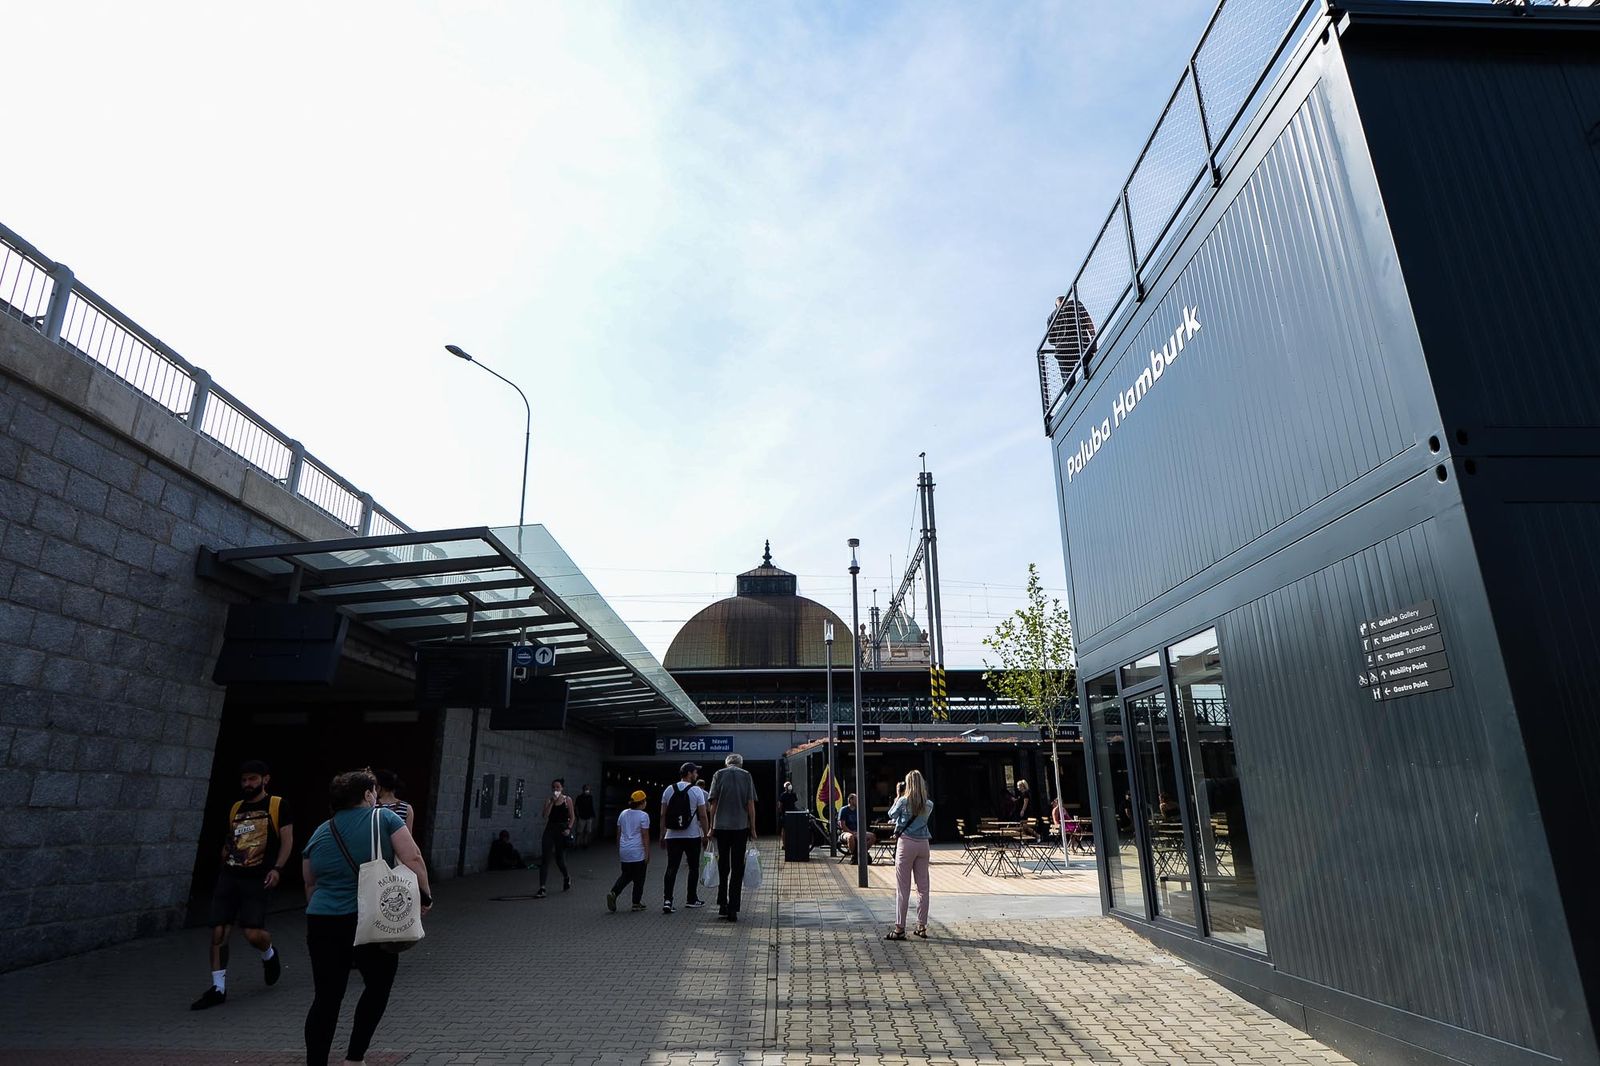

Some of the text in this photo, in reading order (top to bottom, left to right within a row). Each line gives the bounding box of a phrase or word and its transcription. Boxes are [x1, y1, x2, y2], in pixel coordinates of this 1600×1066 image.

[1067, 305, 1202, 482] Paluba Hamburk
[1378, 610, 1419, 626] Galerie Gallery
[1382, 623, 1434, 642] Rozhledna Lookout
[1386, 645, 1426, 659] Terasa Terrace
[1389, 661, 1428, 676] Mobility Point
[1413, 680, 1428, 688] Point
[669, 738, 706, 751] Plzeň
